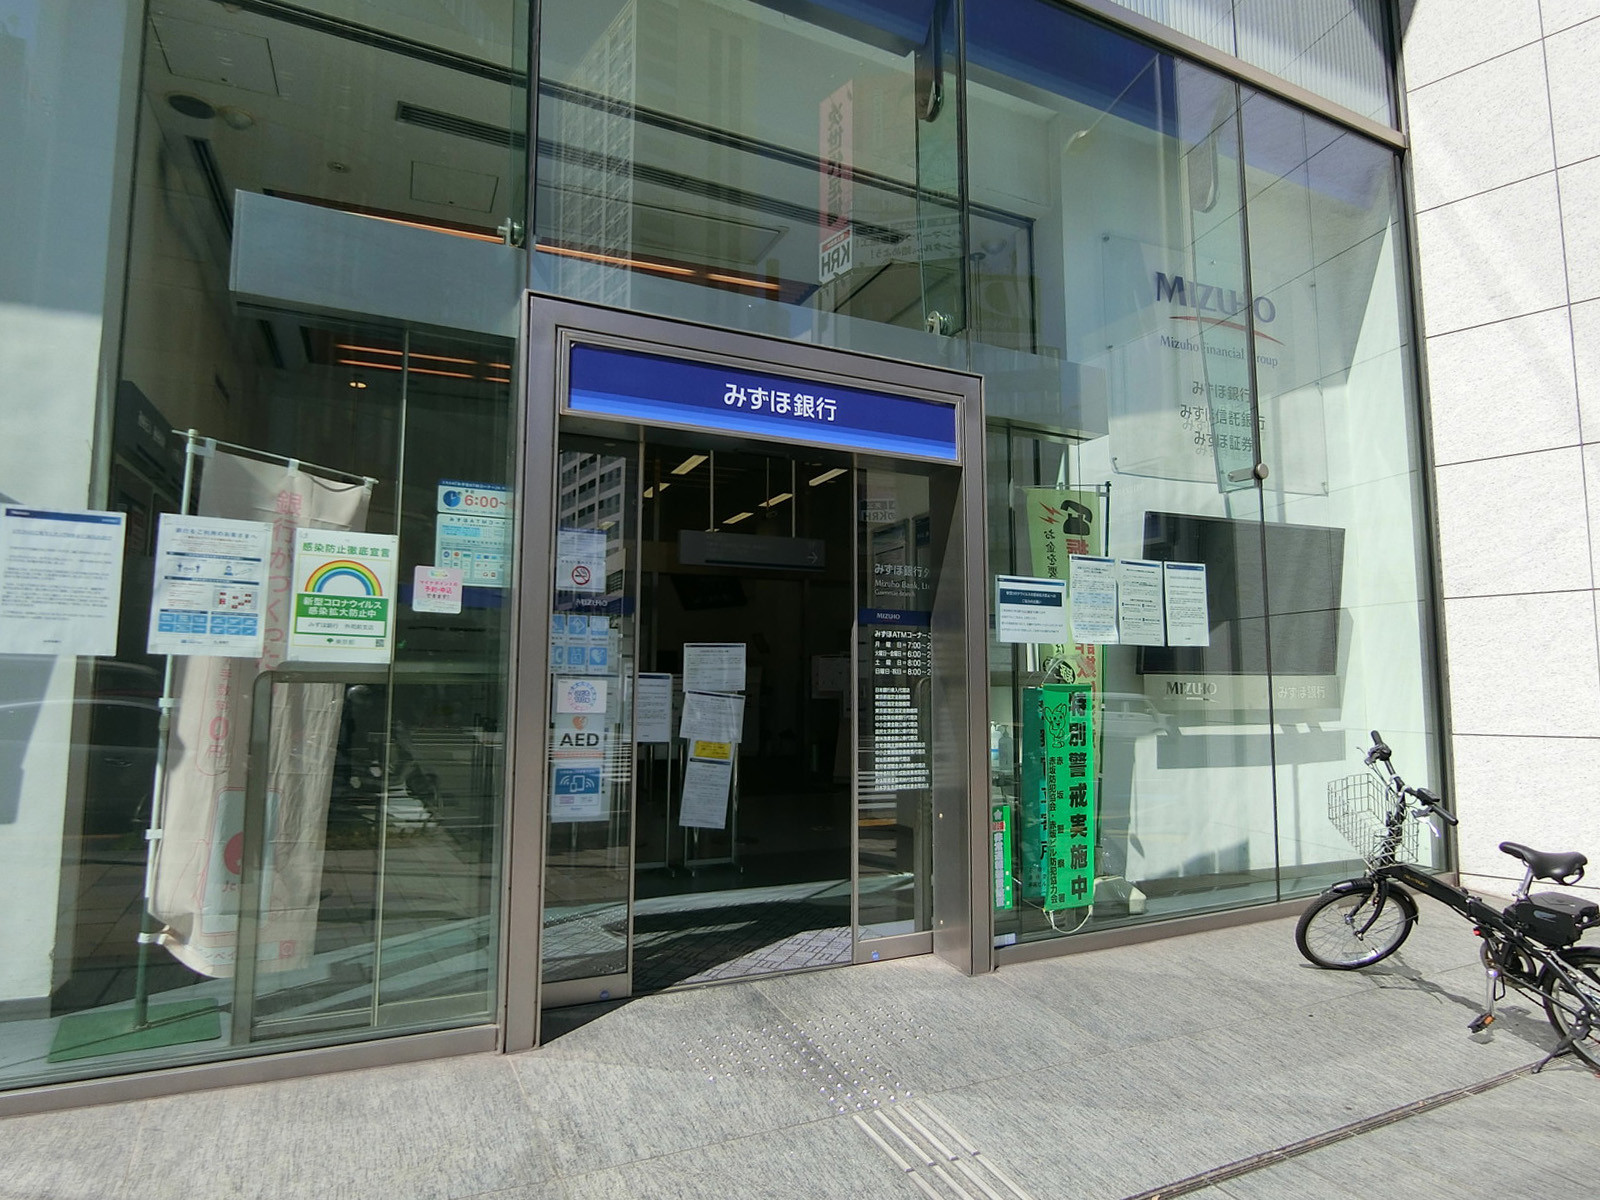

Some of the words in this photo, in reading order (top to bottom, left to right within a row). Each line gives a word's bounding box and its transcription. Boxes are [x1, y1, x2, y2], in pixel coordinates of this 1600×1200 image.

[1160, 335, 1199, 352] Mizuho
[1202, 342, 1244, 360] inancial
[1257, 354, 1278, 368] roup
[723, 382, 838, 421] みずほ銀行
[302, 542, 390, 558] 感染防止徹底宣言
[303, 596, 382, 609] 新型コロナウイルス
[575, 598, 608, 607] MIZUHO
[308, 606, 377, 618] 感染拡大防止中
[876, 612, 901, 620] MIZUHO
[1166, 681, 1217, 695] MIZUHO
[1277, 685, 1326, 699] みずほ銀行
[559, 732, 600, 747] AED
[1068, 691, 1088, 901] 特別警戒実施中
